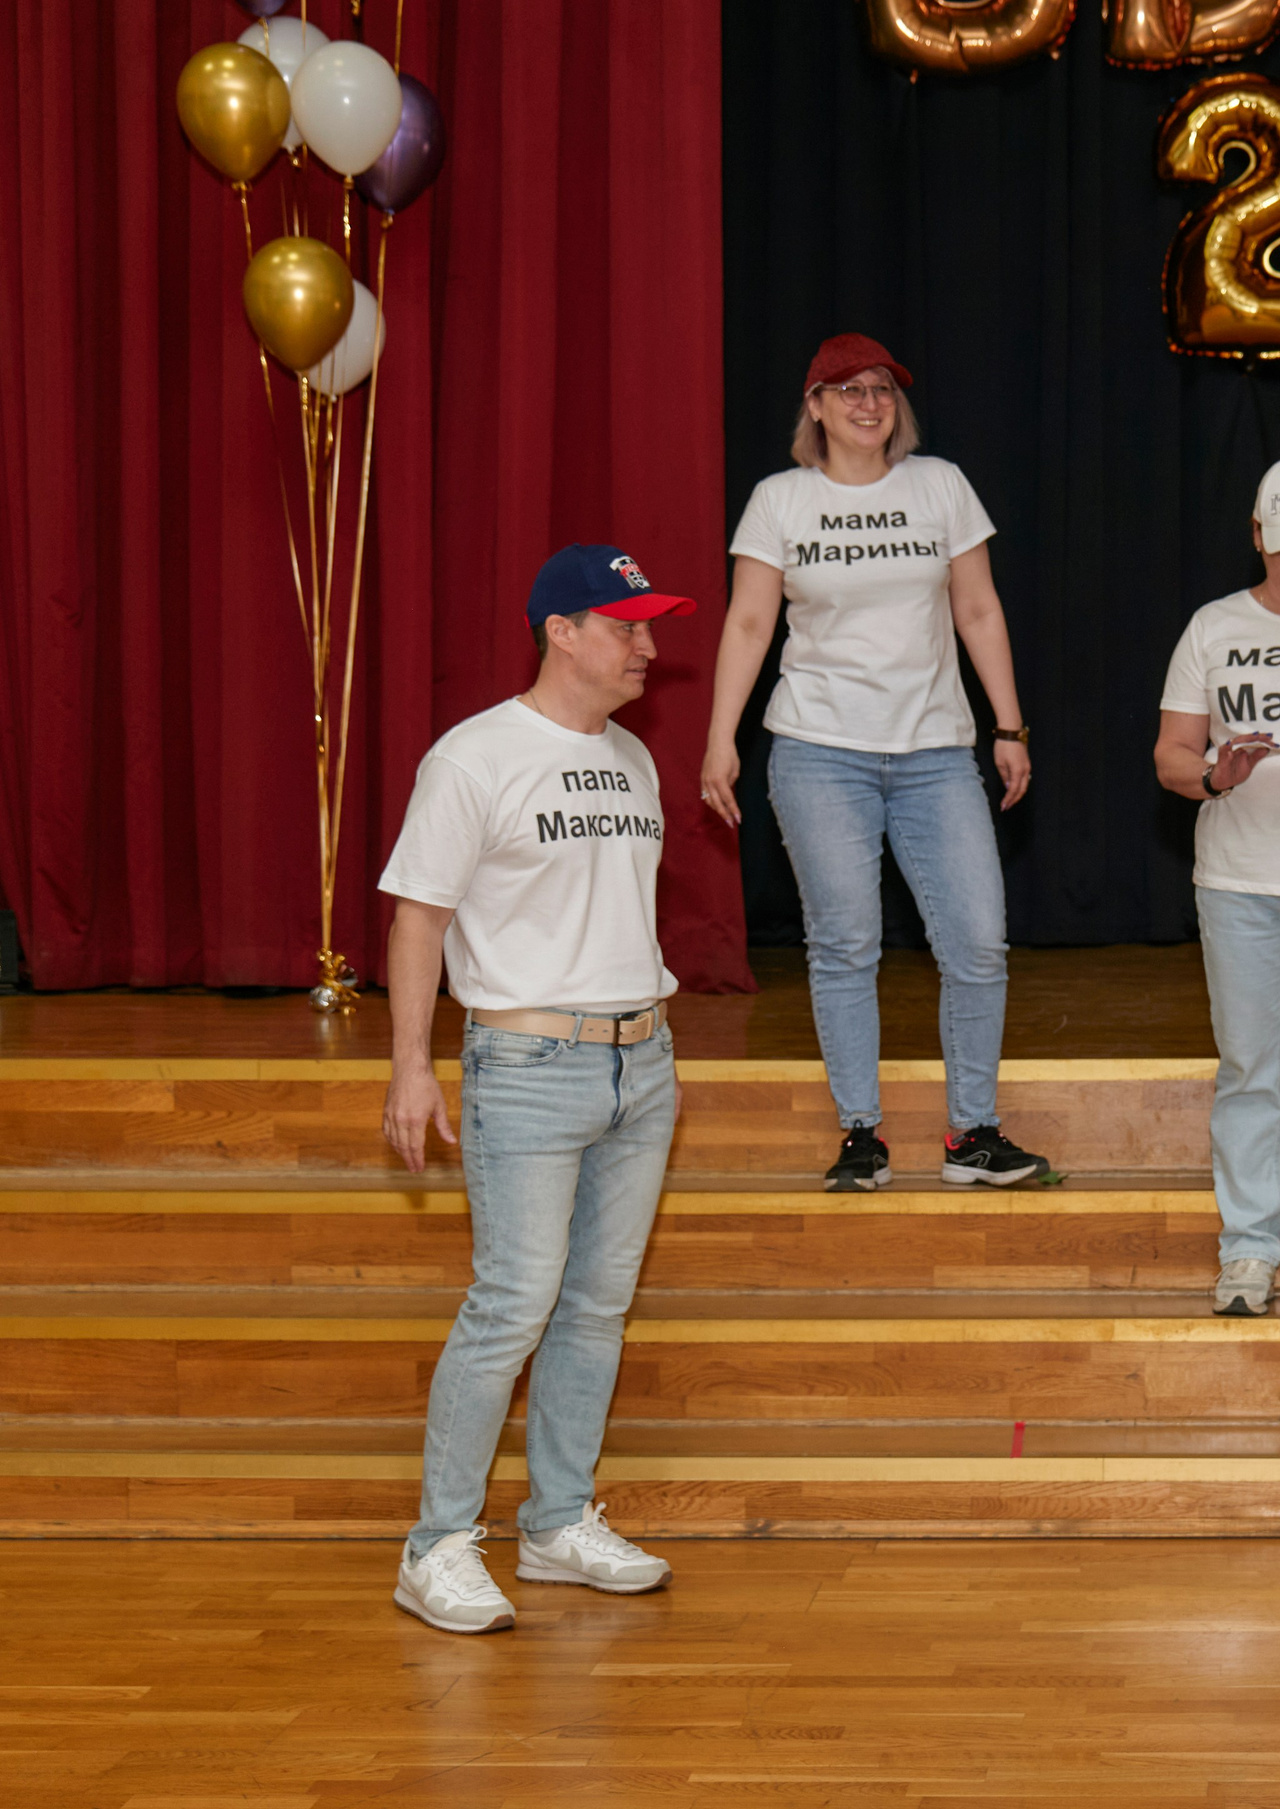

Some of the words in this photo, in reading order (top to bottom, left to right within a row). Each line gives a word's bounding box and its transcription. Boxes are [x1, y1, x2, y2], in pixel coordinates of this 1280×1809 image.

[821, 511, 908, 530] мама
[796, 541, 938, 566] Марины
[562, 769, 631, 793] папа
[536, 810, 661, 843] Максима
